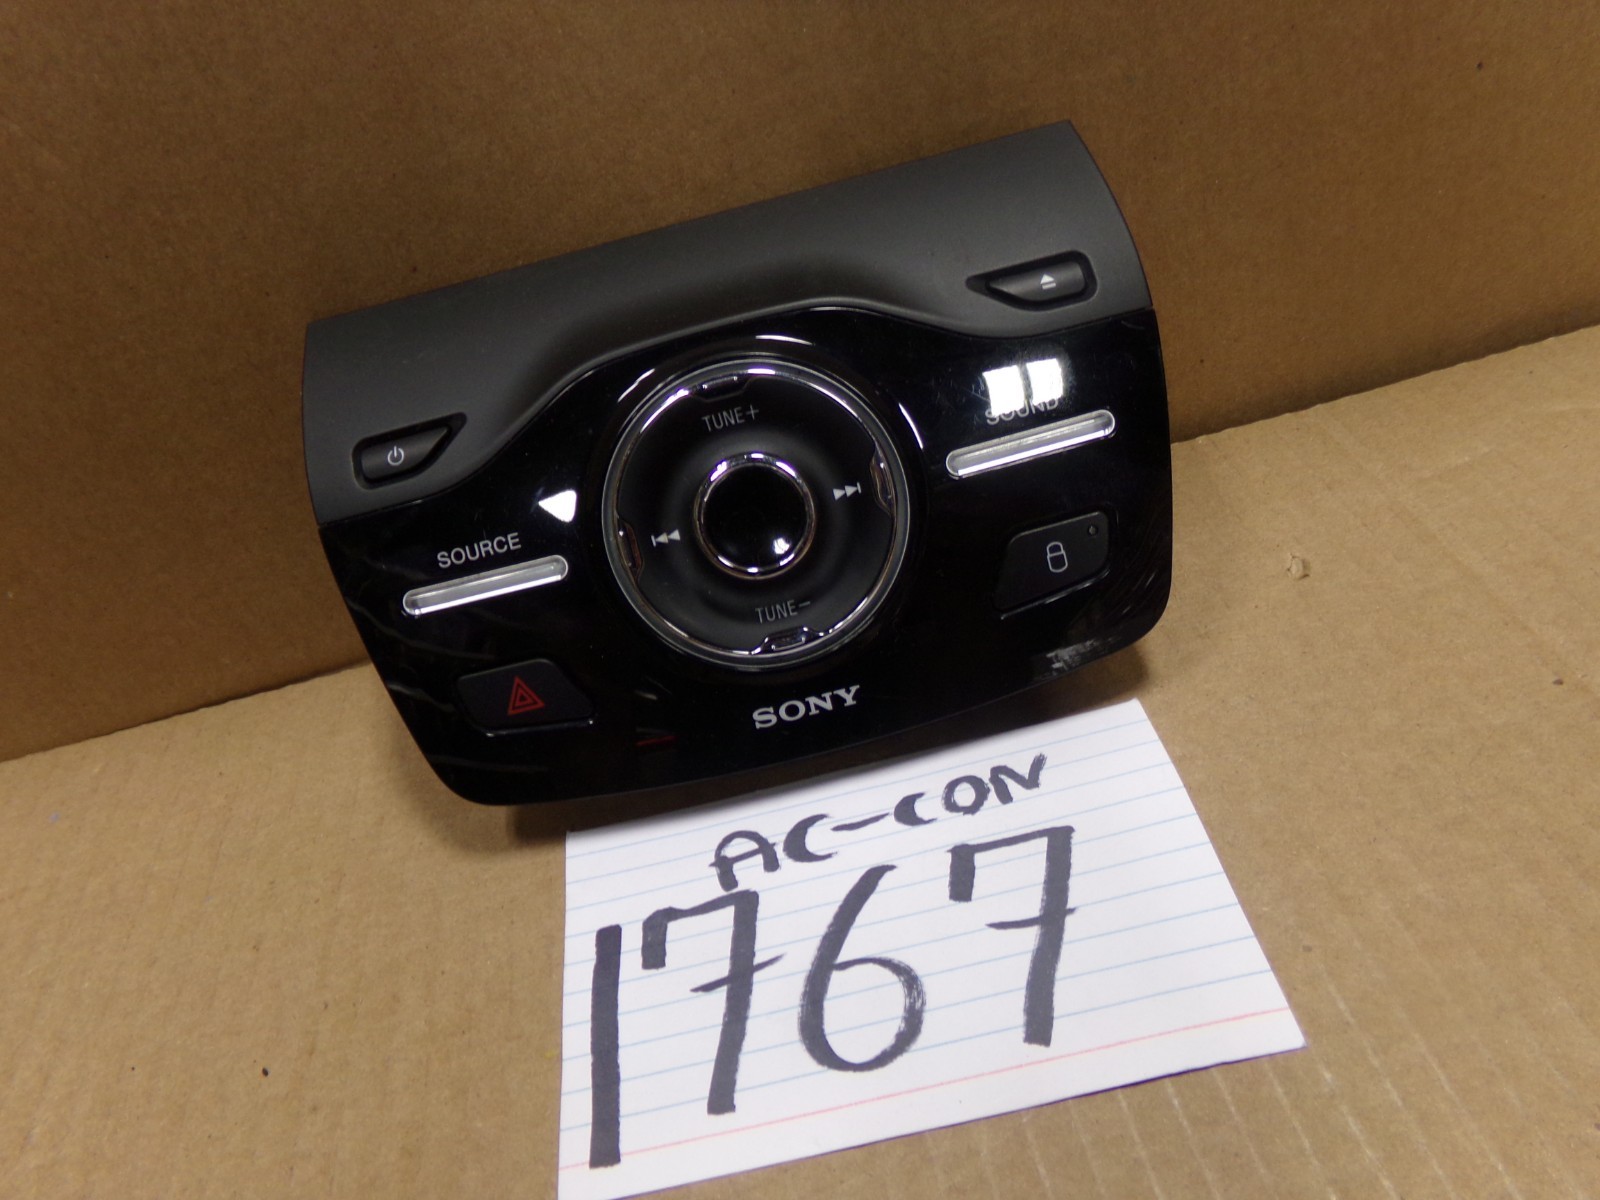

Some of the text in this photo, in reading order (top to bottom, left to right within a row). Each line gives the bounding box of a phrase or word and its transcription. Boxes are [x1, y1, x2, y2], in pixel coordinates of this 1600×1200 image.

[437, 532, 522, 568] SOURCE
[752, 685, 860, 730] SONY
[710, 753, 1047, 891] AC-CON
[589, 826, 1077, 1168] 1767
